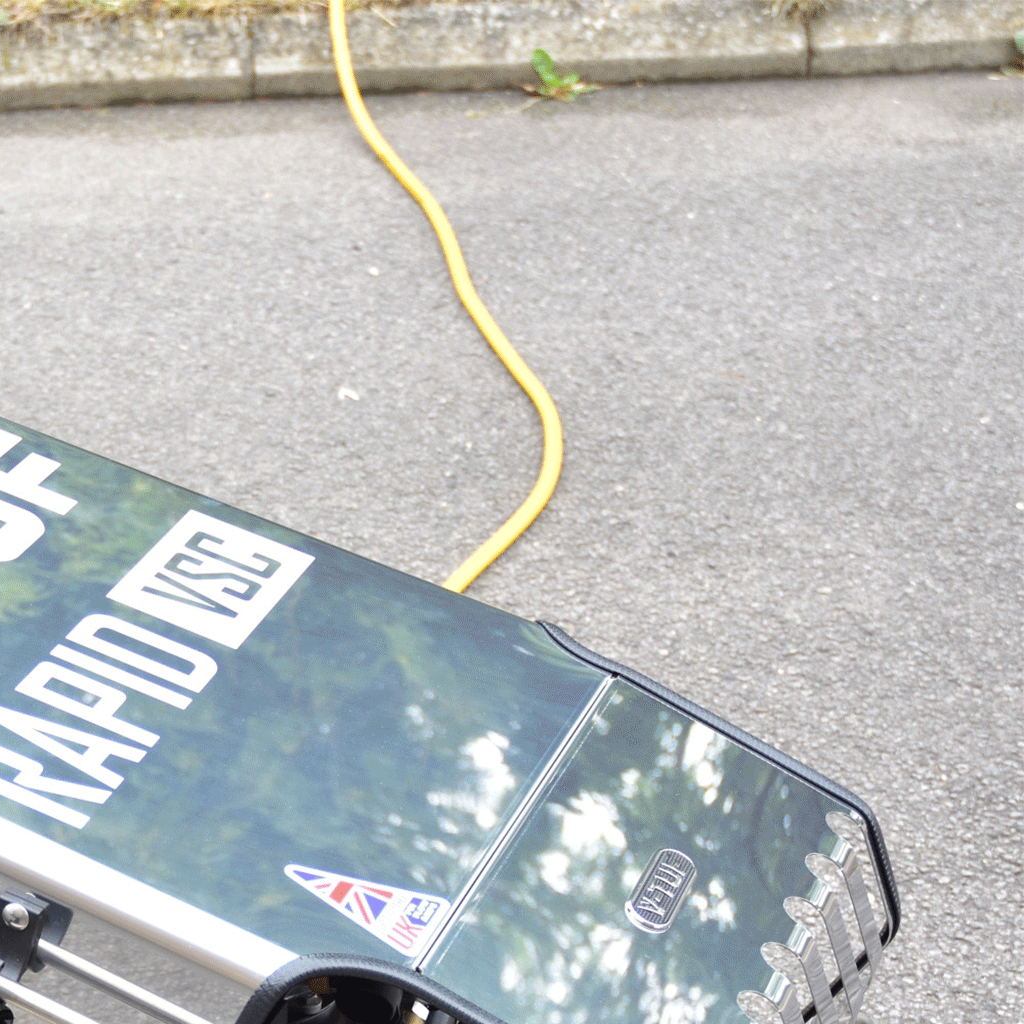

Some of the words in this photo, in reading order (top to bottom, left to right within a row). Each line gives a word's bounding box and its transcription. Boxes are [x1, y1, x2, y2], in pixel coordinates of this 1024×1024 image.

[140, 531, 282, 619] VSC
[637, 852, 685, 916] V-TUF
[387, 915, 423, 949] UK
